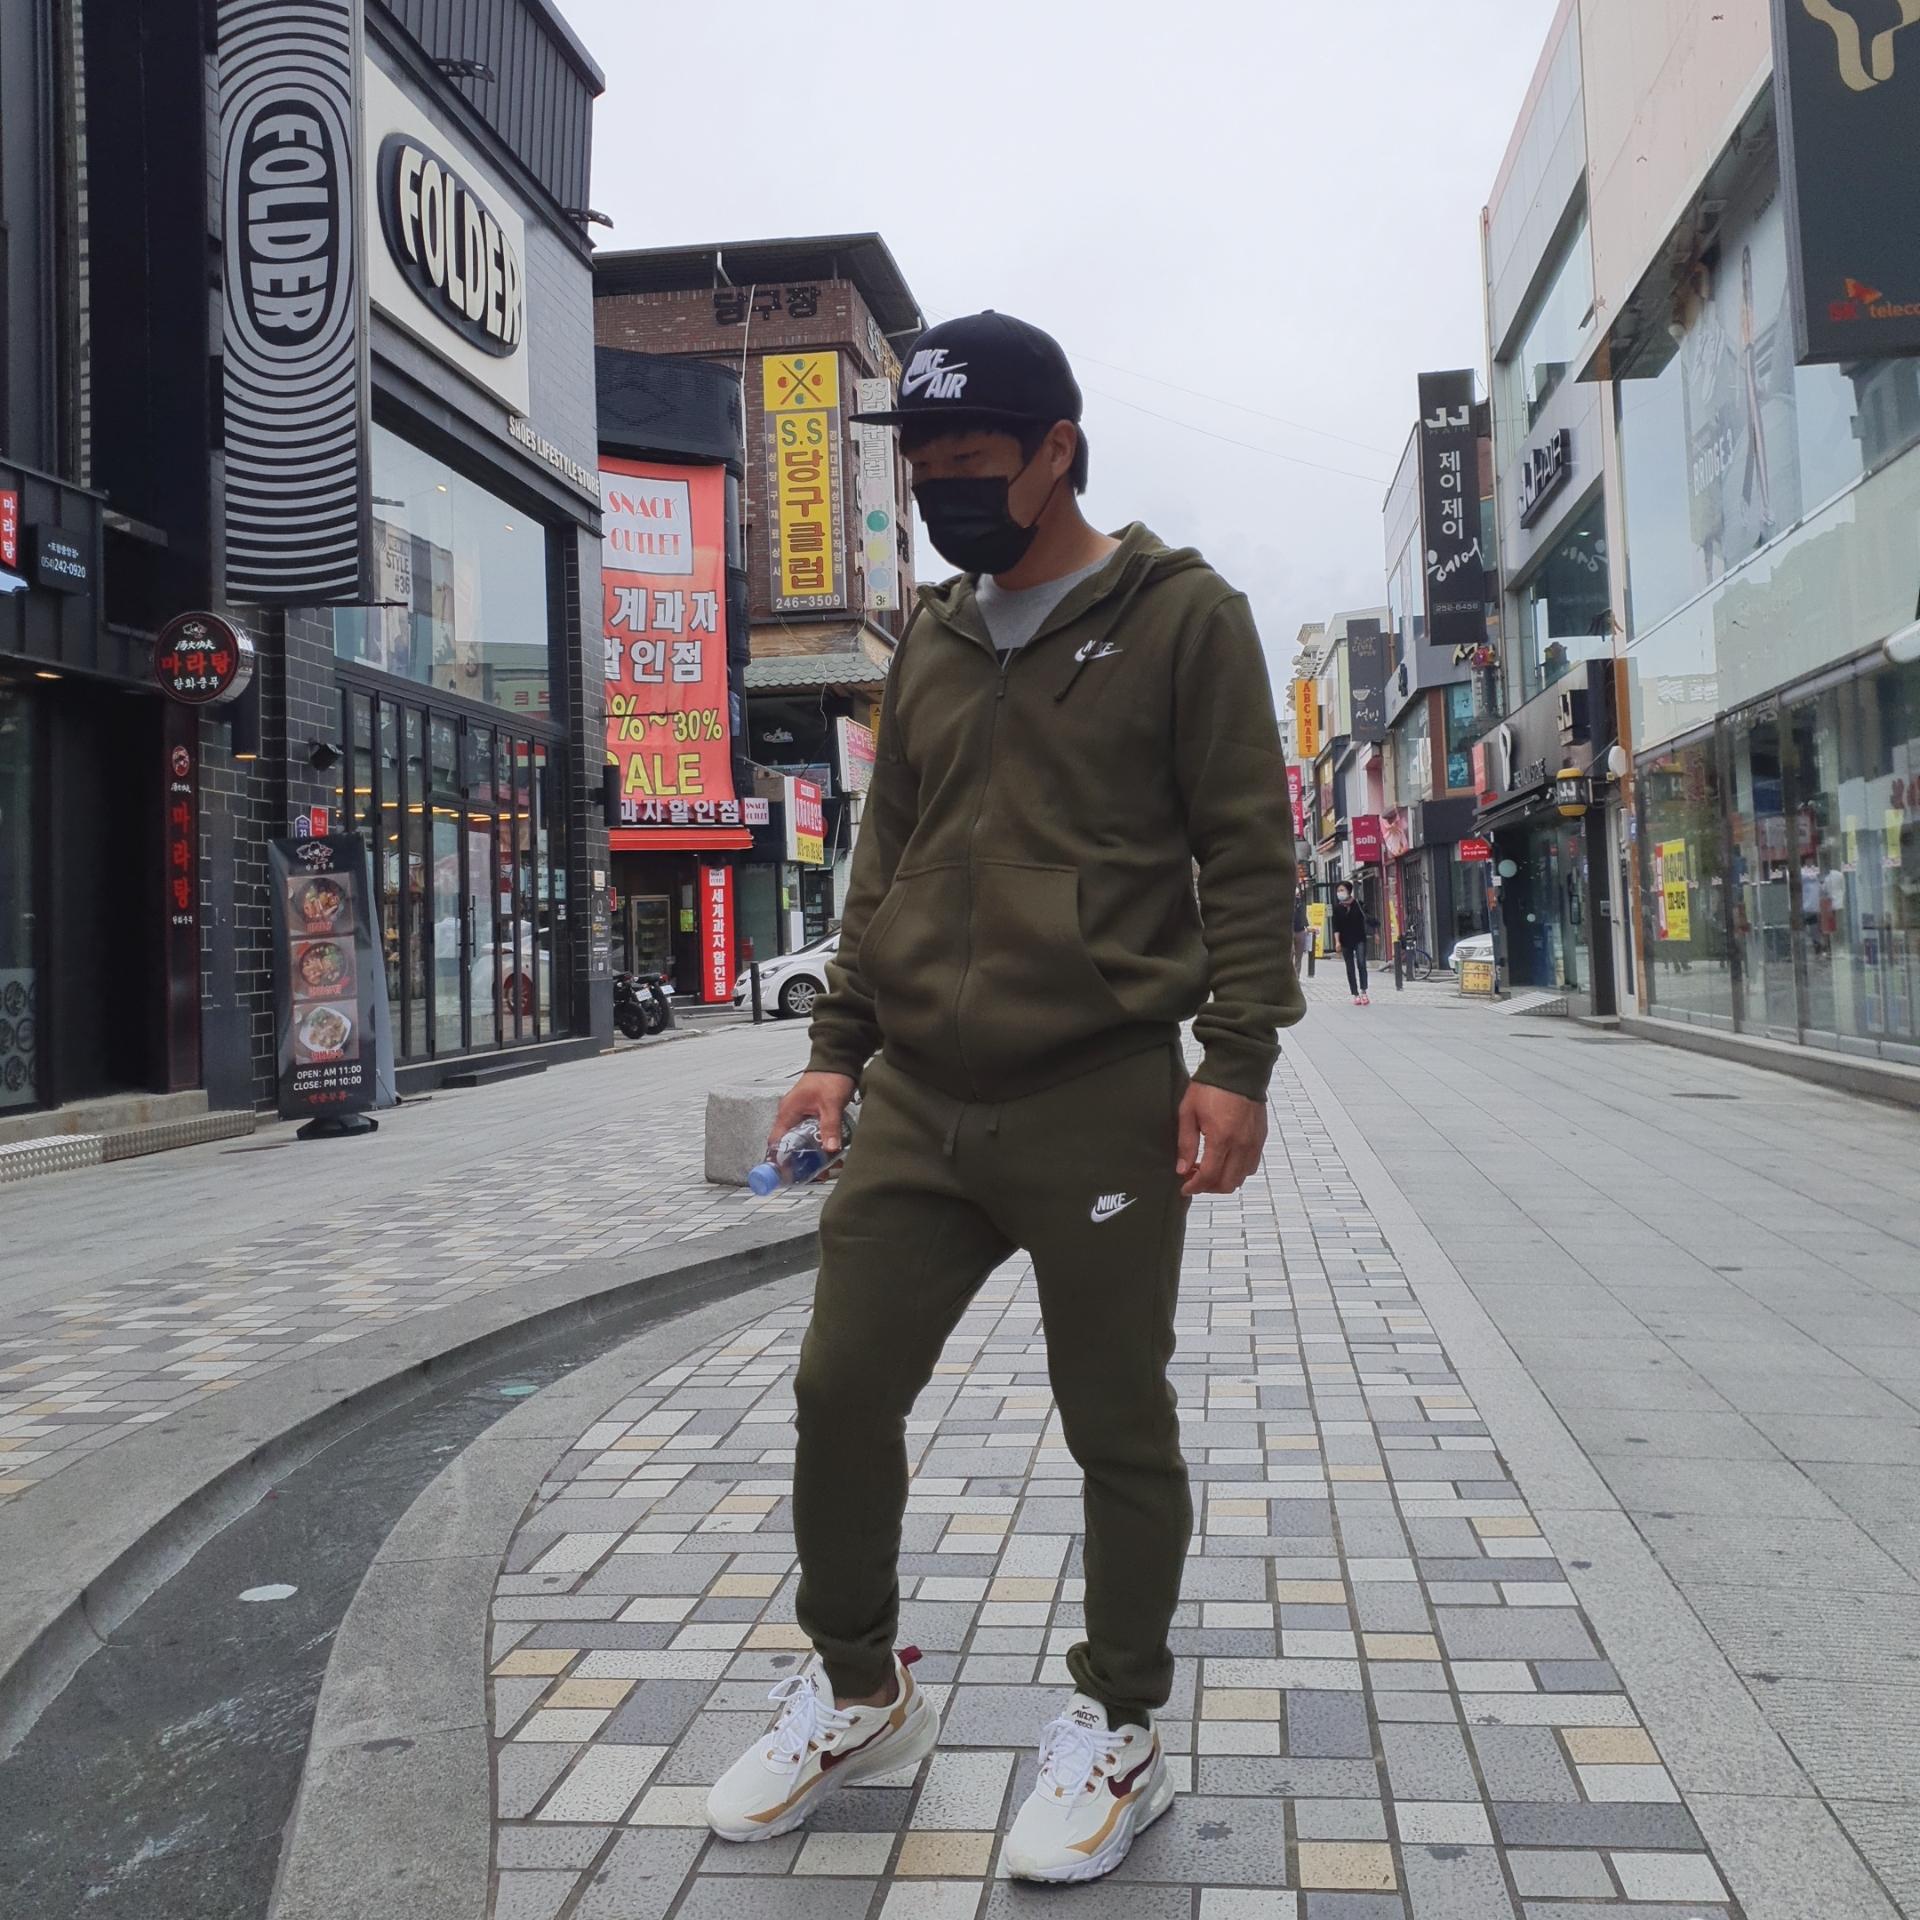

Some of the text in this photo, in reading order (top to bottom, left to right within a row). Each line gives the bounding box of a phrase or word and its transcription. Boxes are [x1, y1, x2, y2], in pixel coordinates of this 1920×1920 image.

[248, 113, 330, 332] FOLDER
[400, 145, 522, 345] FOLDER
[714, 286, 821, 325] 당구장
[909, 349, 949, 376] NIKE
[924, 373, 968, 399] AIR
[1425, 405, 1470, 428] JJ
[509, 415, 600, 498] SHOES LIFESTYLE STORE
[1693, 440, 1725, 497] BRIDGE
[609, 491, 680, 519] SNACK
[781, 418, 826, 590] S.S 당구클럽
[1439, 451, 1464, 540] 제이제이
[2, 497, 15, 559] 마라탕
[610, 528, 681, 555] OUTLET
[386, 552, 410, 574] STYLE
[394, 575, 411, 594] #36
[601, 586, 718, 634] 계과자
[776, 594, 841, 609] 246-3509
[161, 651, 232, 676] 마라탕
[173, 676, 220, 691] 탕화쿵푸
[605, 694, 723, 742] %~30%
[606, 751, 704, 796] ALE
[1560, 781, 1576, 797] JJ
[745, 803, 768, 811] SNACK
[172, 802, 191, 909] 마라탕
[711, 888, 727, 997] 세계과자할인점
[293, 1076, 362, 1091] CLOSE: PM 10:00
[296, 1065, 362, 1080] OPEN: AM 11:00
[1097, 1192, 1126, 1211] NIKE
